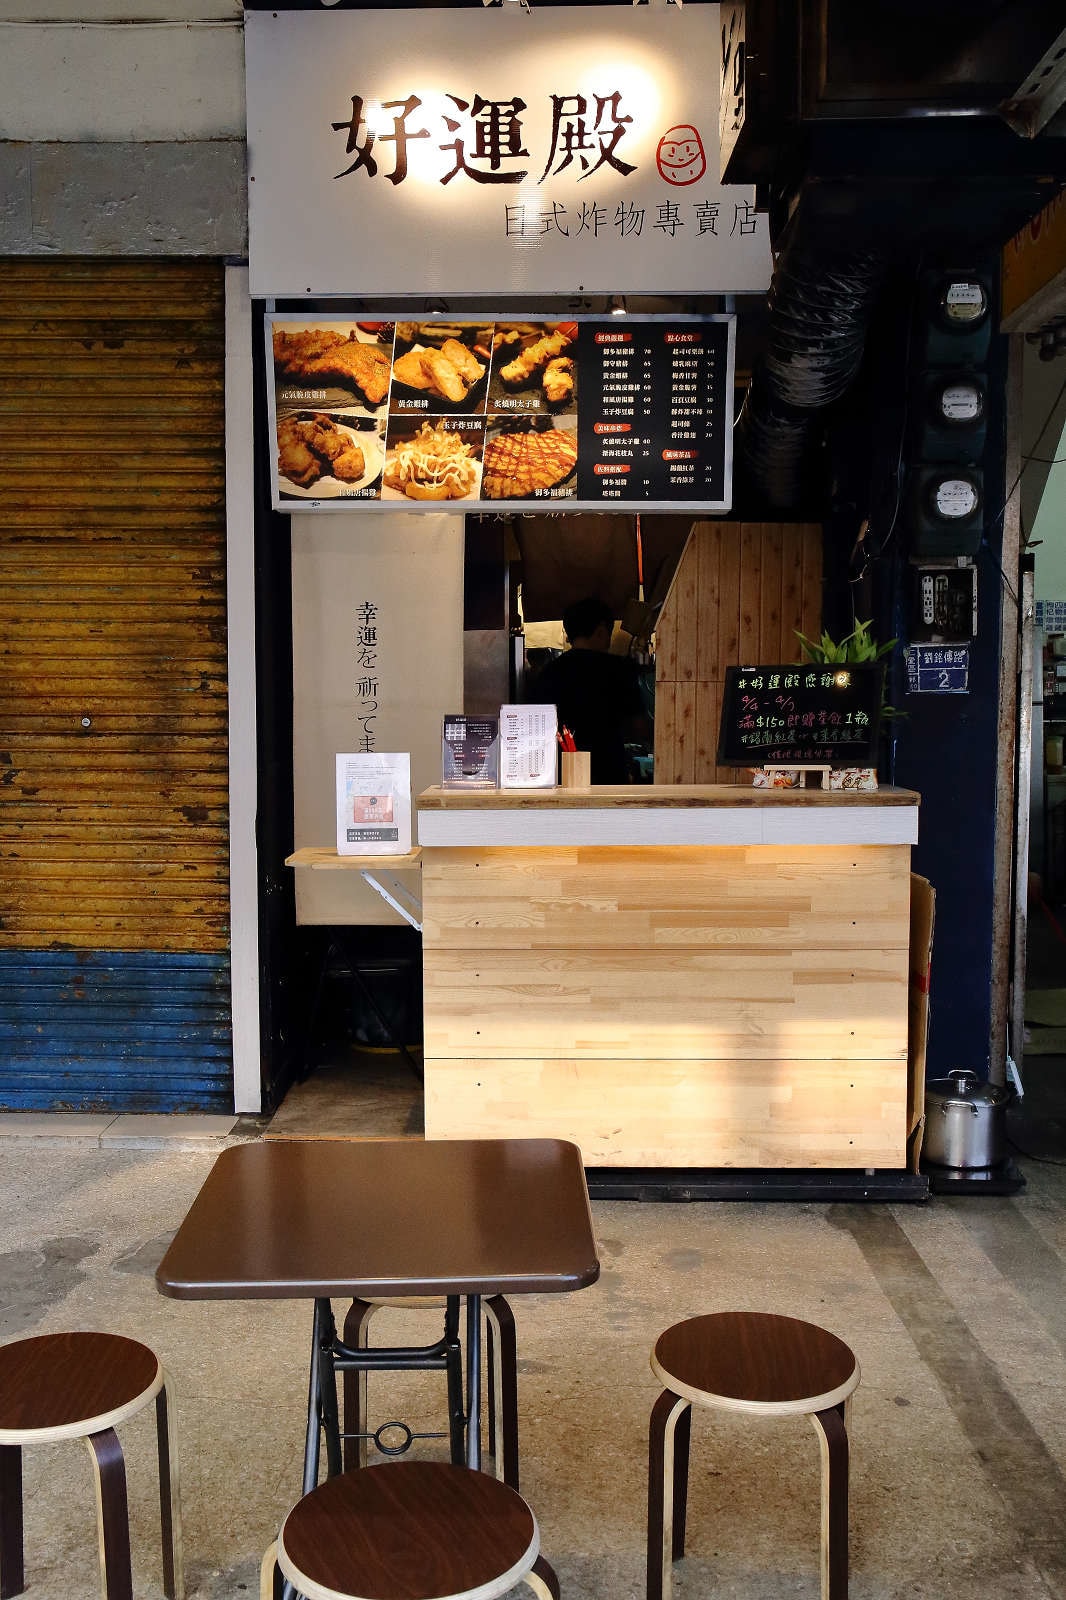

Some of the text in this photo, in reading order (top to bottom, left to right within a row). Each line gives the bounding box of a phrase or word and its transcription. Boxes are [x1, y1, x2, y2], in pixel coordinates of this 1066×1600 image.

[331, 91, 638, 185] 好運殿
[503, 199, 759, 239] 日式炸物專賣店
[939, 672, 951, 688] 2
